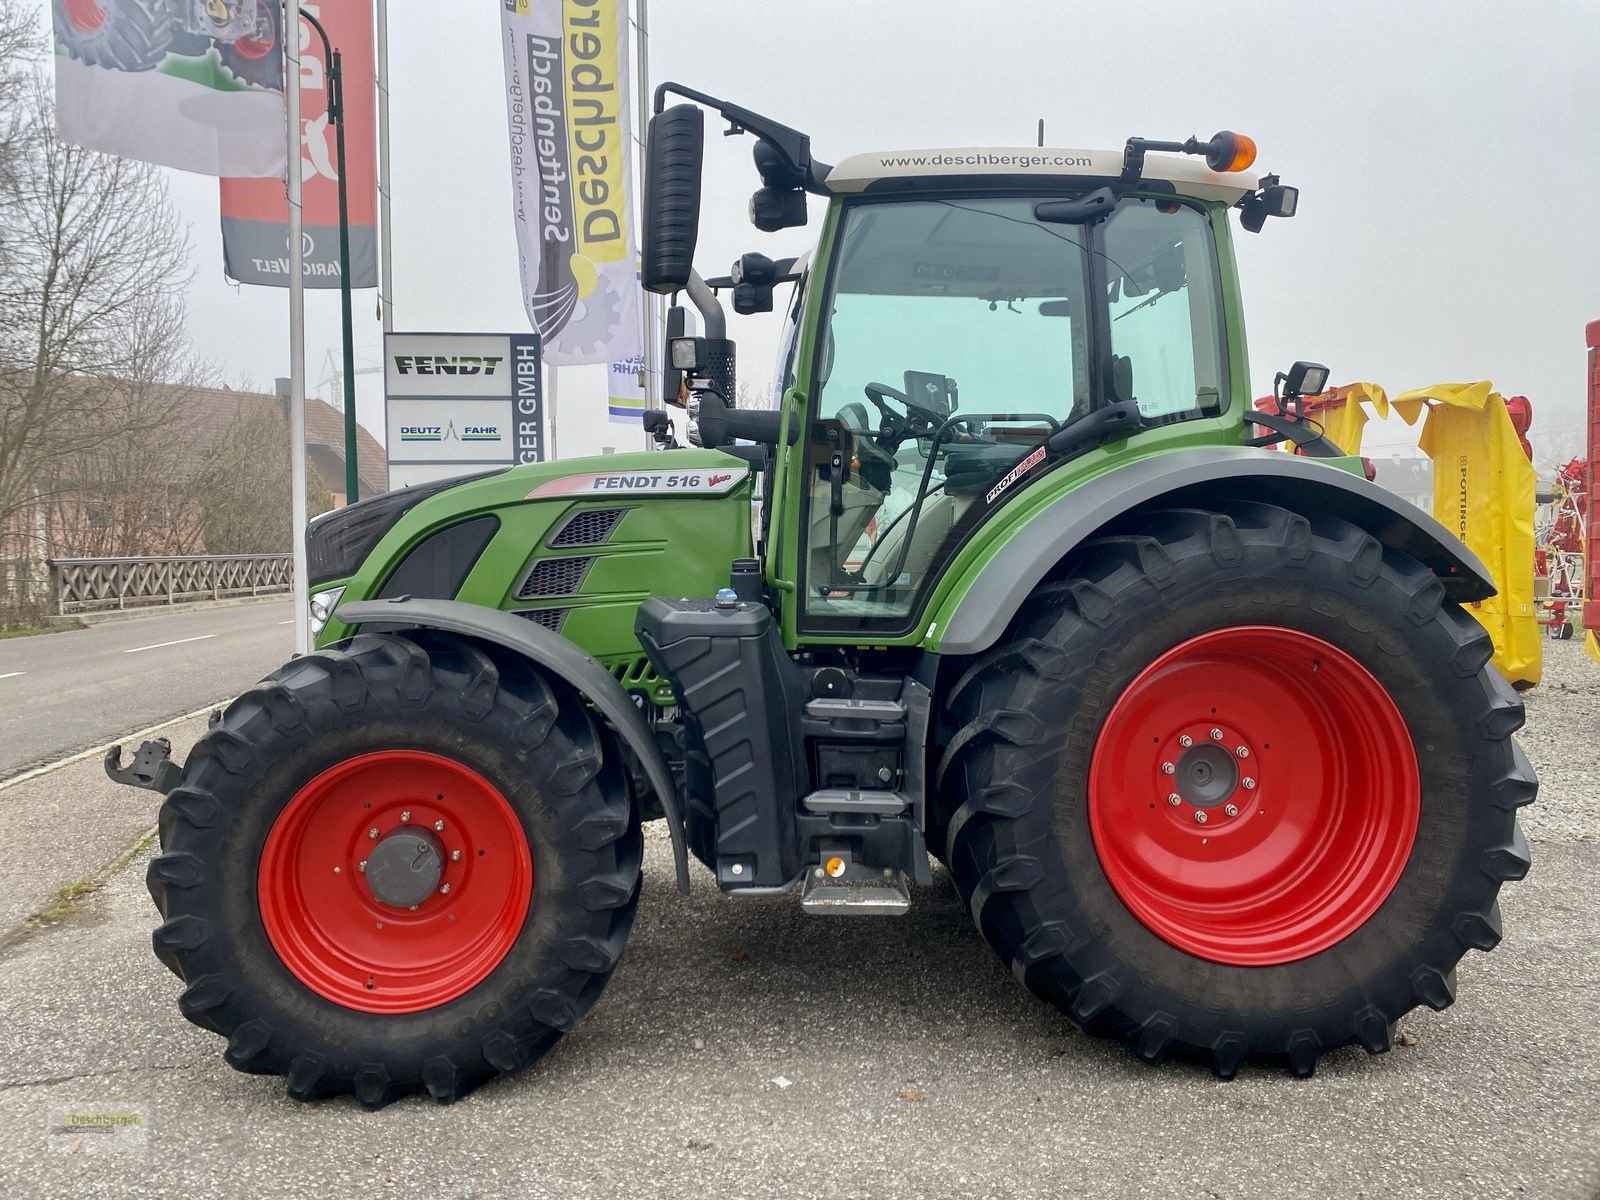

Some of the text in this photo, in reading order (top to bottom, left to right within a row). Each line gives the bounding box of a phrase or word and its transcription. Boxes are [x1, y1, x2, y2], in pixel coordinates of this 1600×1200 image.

[880, 153, 1093, 168] www.deschberger.com
[393, 355, 504, 376] FENDT
[516, 345, 536, 415] GMBH
[400, 426, 498, 435] DEUTZ FAHR
[593, 476, 661, 488] FENDT
[666, 475, 701, 487] 516
